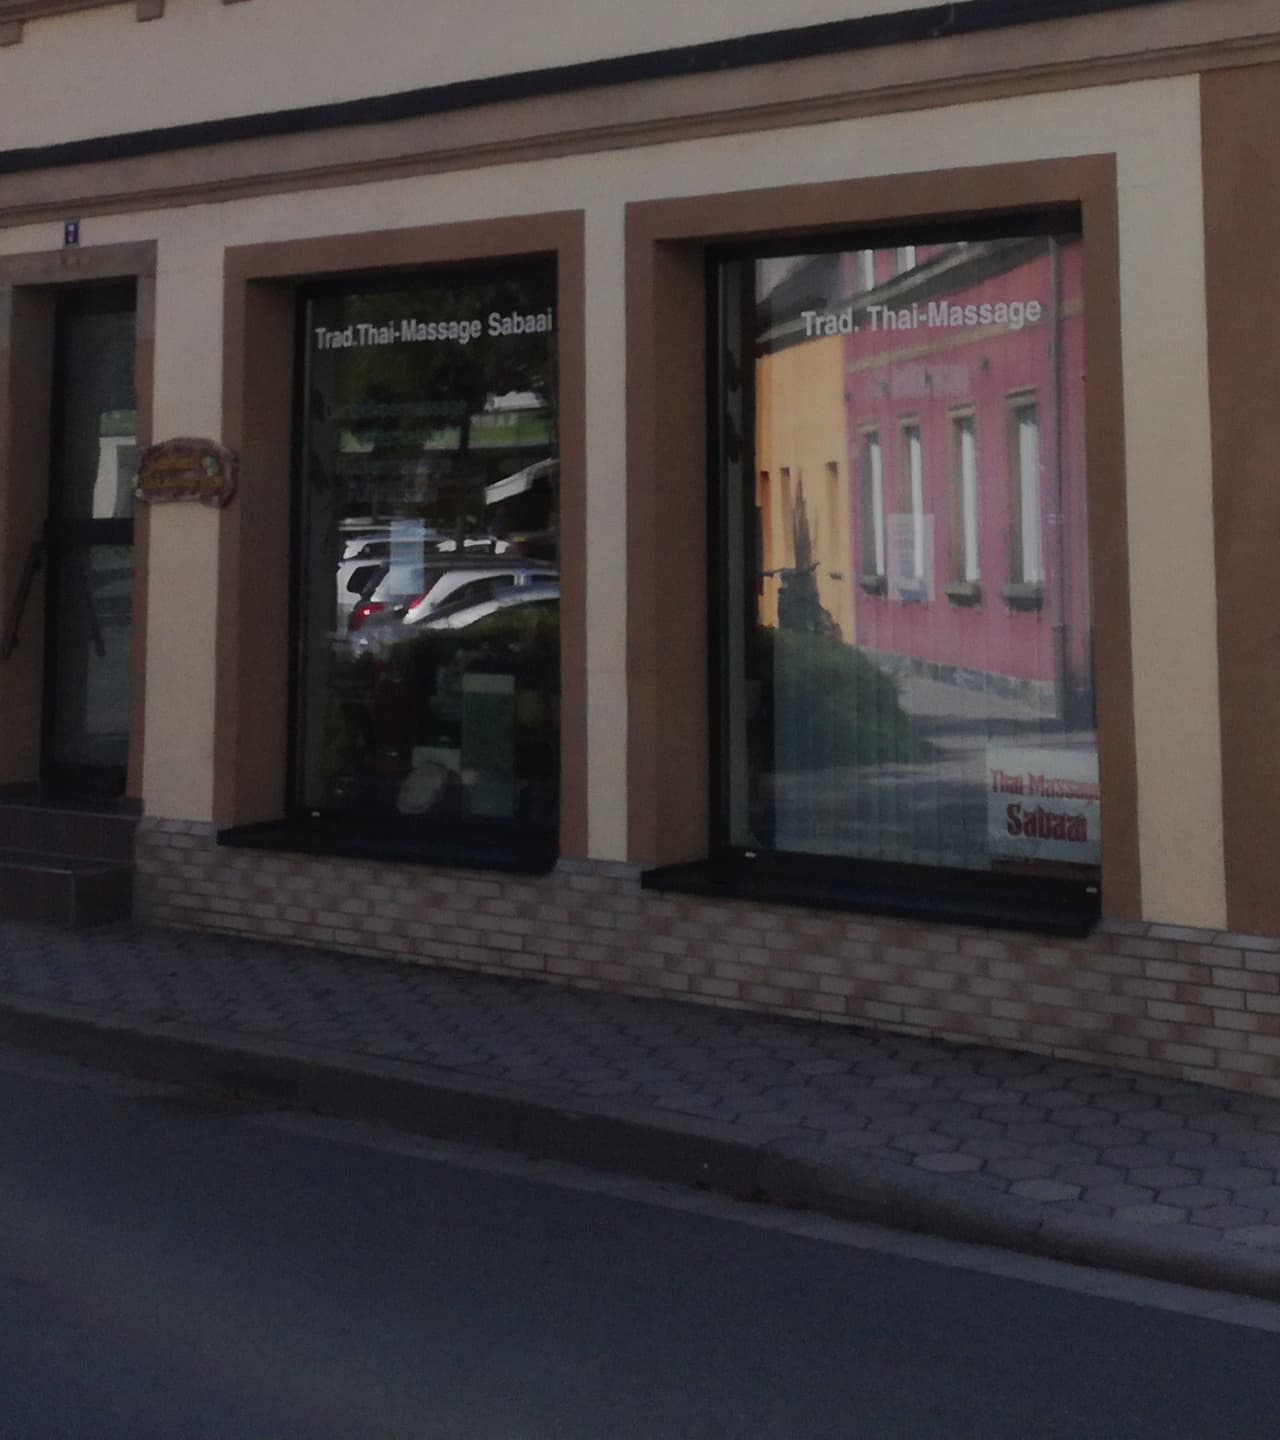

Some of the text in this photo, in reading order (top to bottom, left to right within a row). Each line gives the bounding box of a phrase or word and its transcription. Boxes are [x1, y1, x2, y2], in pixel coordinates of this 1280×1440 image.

[315, 308, 553, 349] Trad.Thai-Massage Sabaai
[801, 299, 1042, 337] Trad. Thai-Massage
